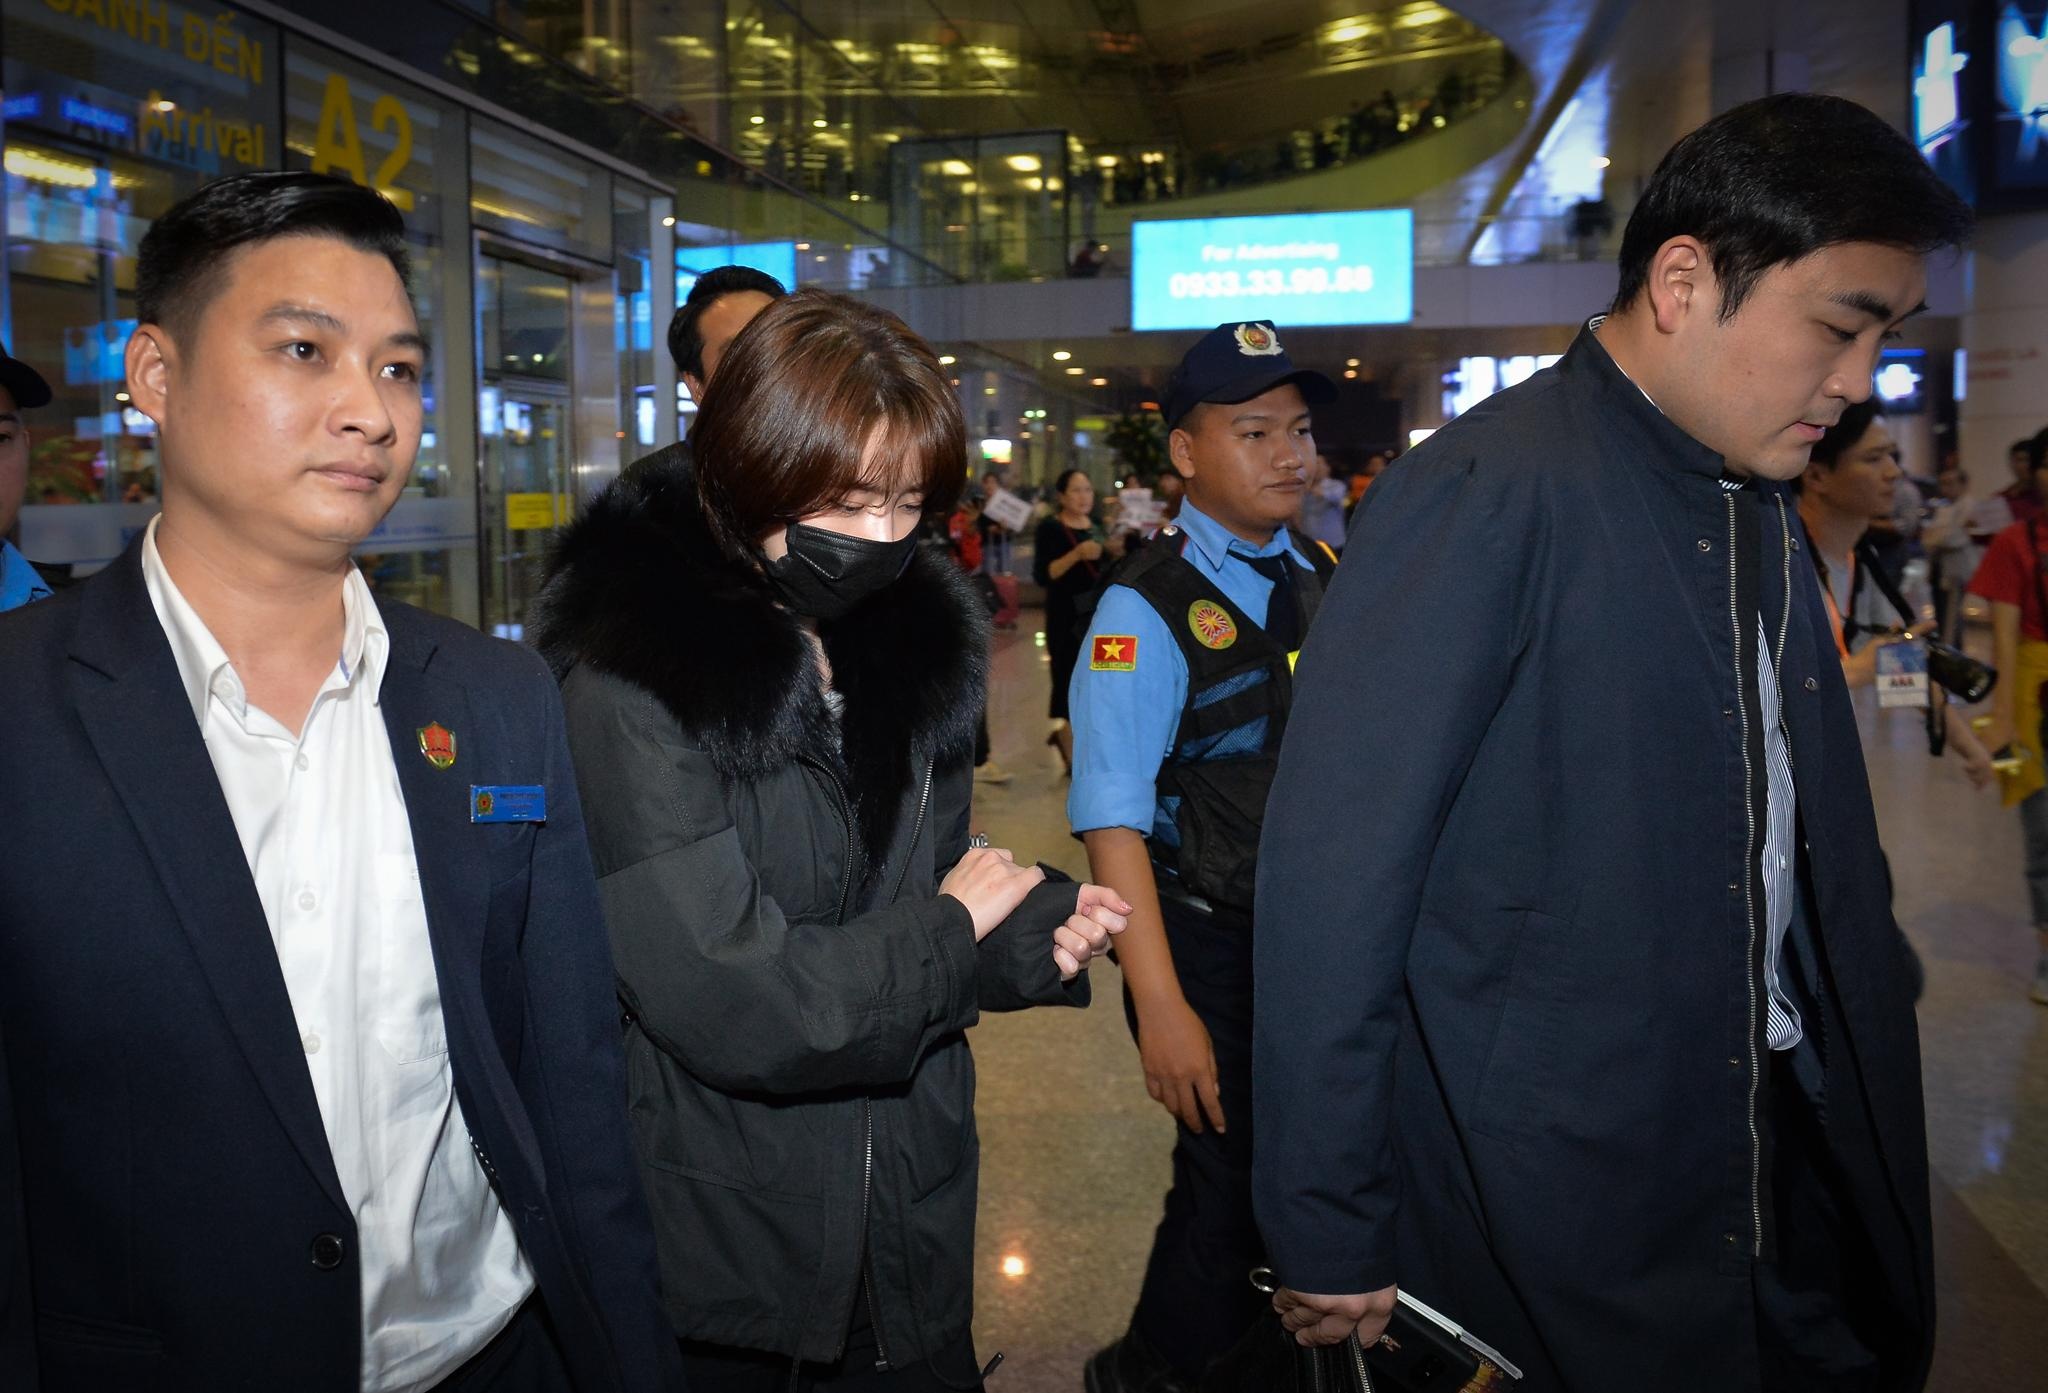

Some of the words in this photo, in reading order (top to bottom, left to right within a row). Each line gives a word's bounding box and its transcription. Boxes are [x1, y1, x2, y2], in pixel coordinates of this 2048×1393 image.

[42, 0, 170, 49] NH
[183, 10, 264, 85] ĐẾN
[141, 89, 265, 167] Arrival
[311, 73, 414, 213] A2
[1201, 244, 1233, 262] For
[1235, 241, 1341, 261] Advertising
